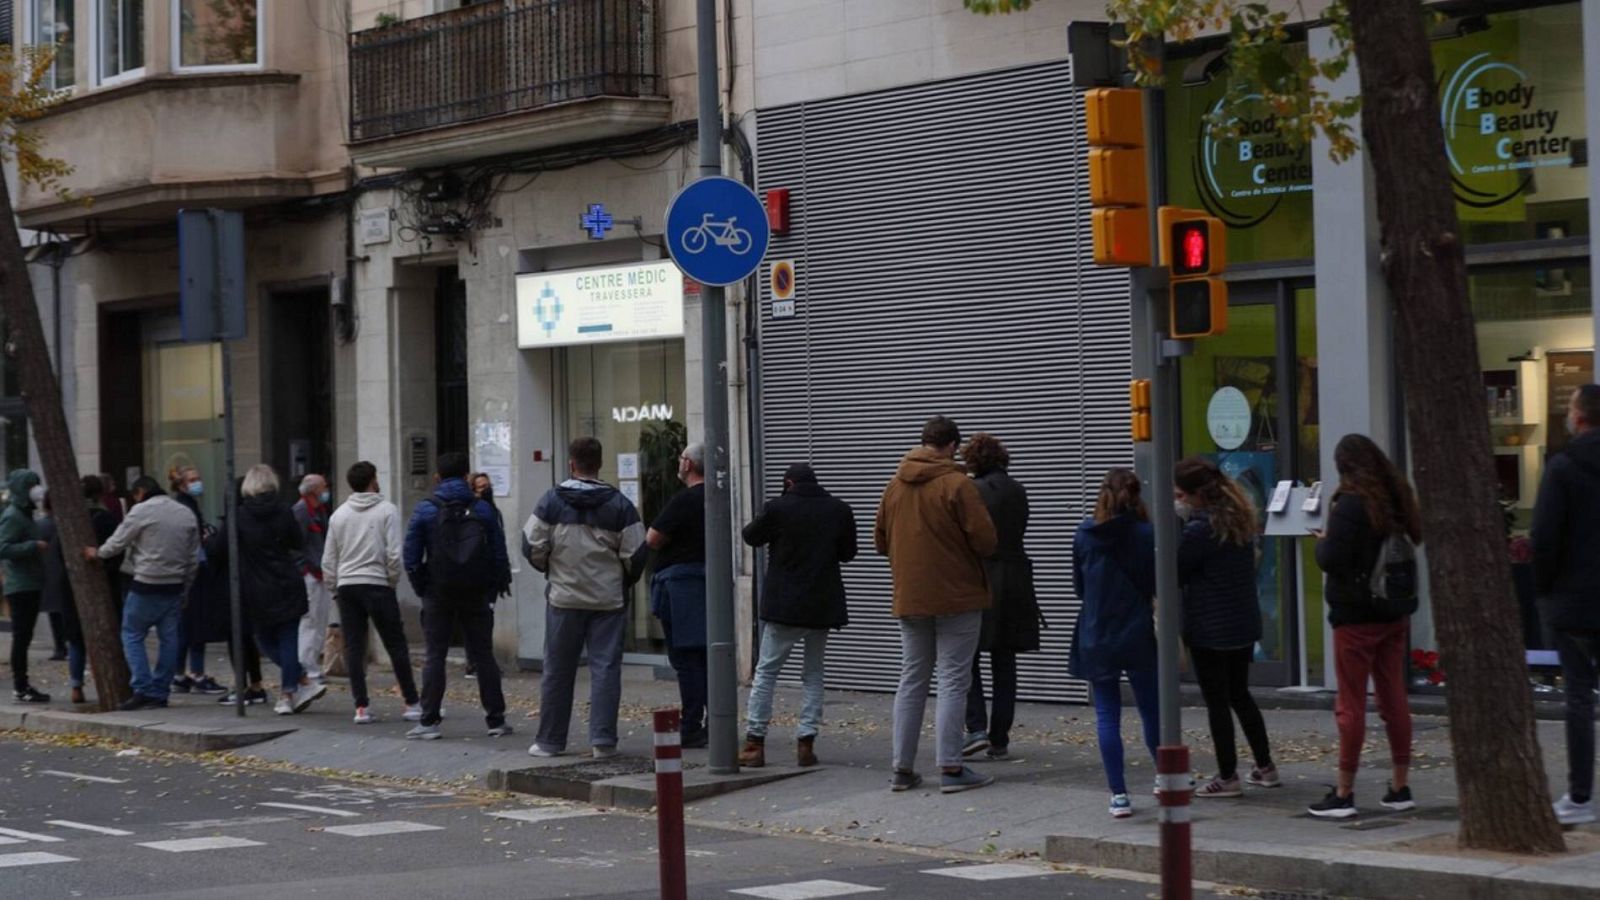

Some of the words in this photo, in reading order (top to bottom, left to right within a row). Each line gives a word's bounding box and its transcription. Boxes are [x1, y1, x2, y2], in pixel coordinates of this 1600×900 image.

[1465, 82, 1535, 110] Ebody
[1480, 109, 1559, 135] Beauty
[1496, 135, 1570, 160] Center
[575, 273, 623, 291] CENTRE
[590, 288, 653, 302] TRAVESSERA
